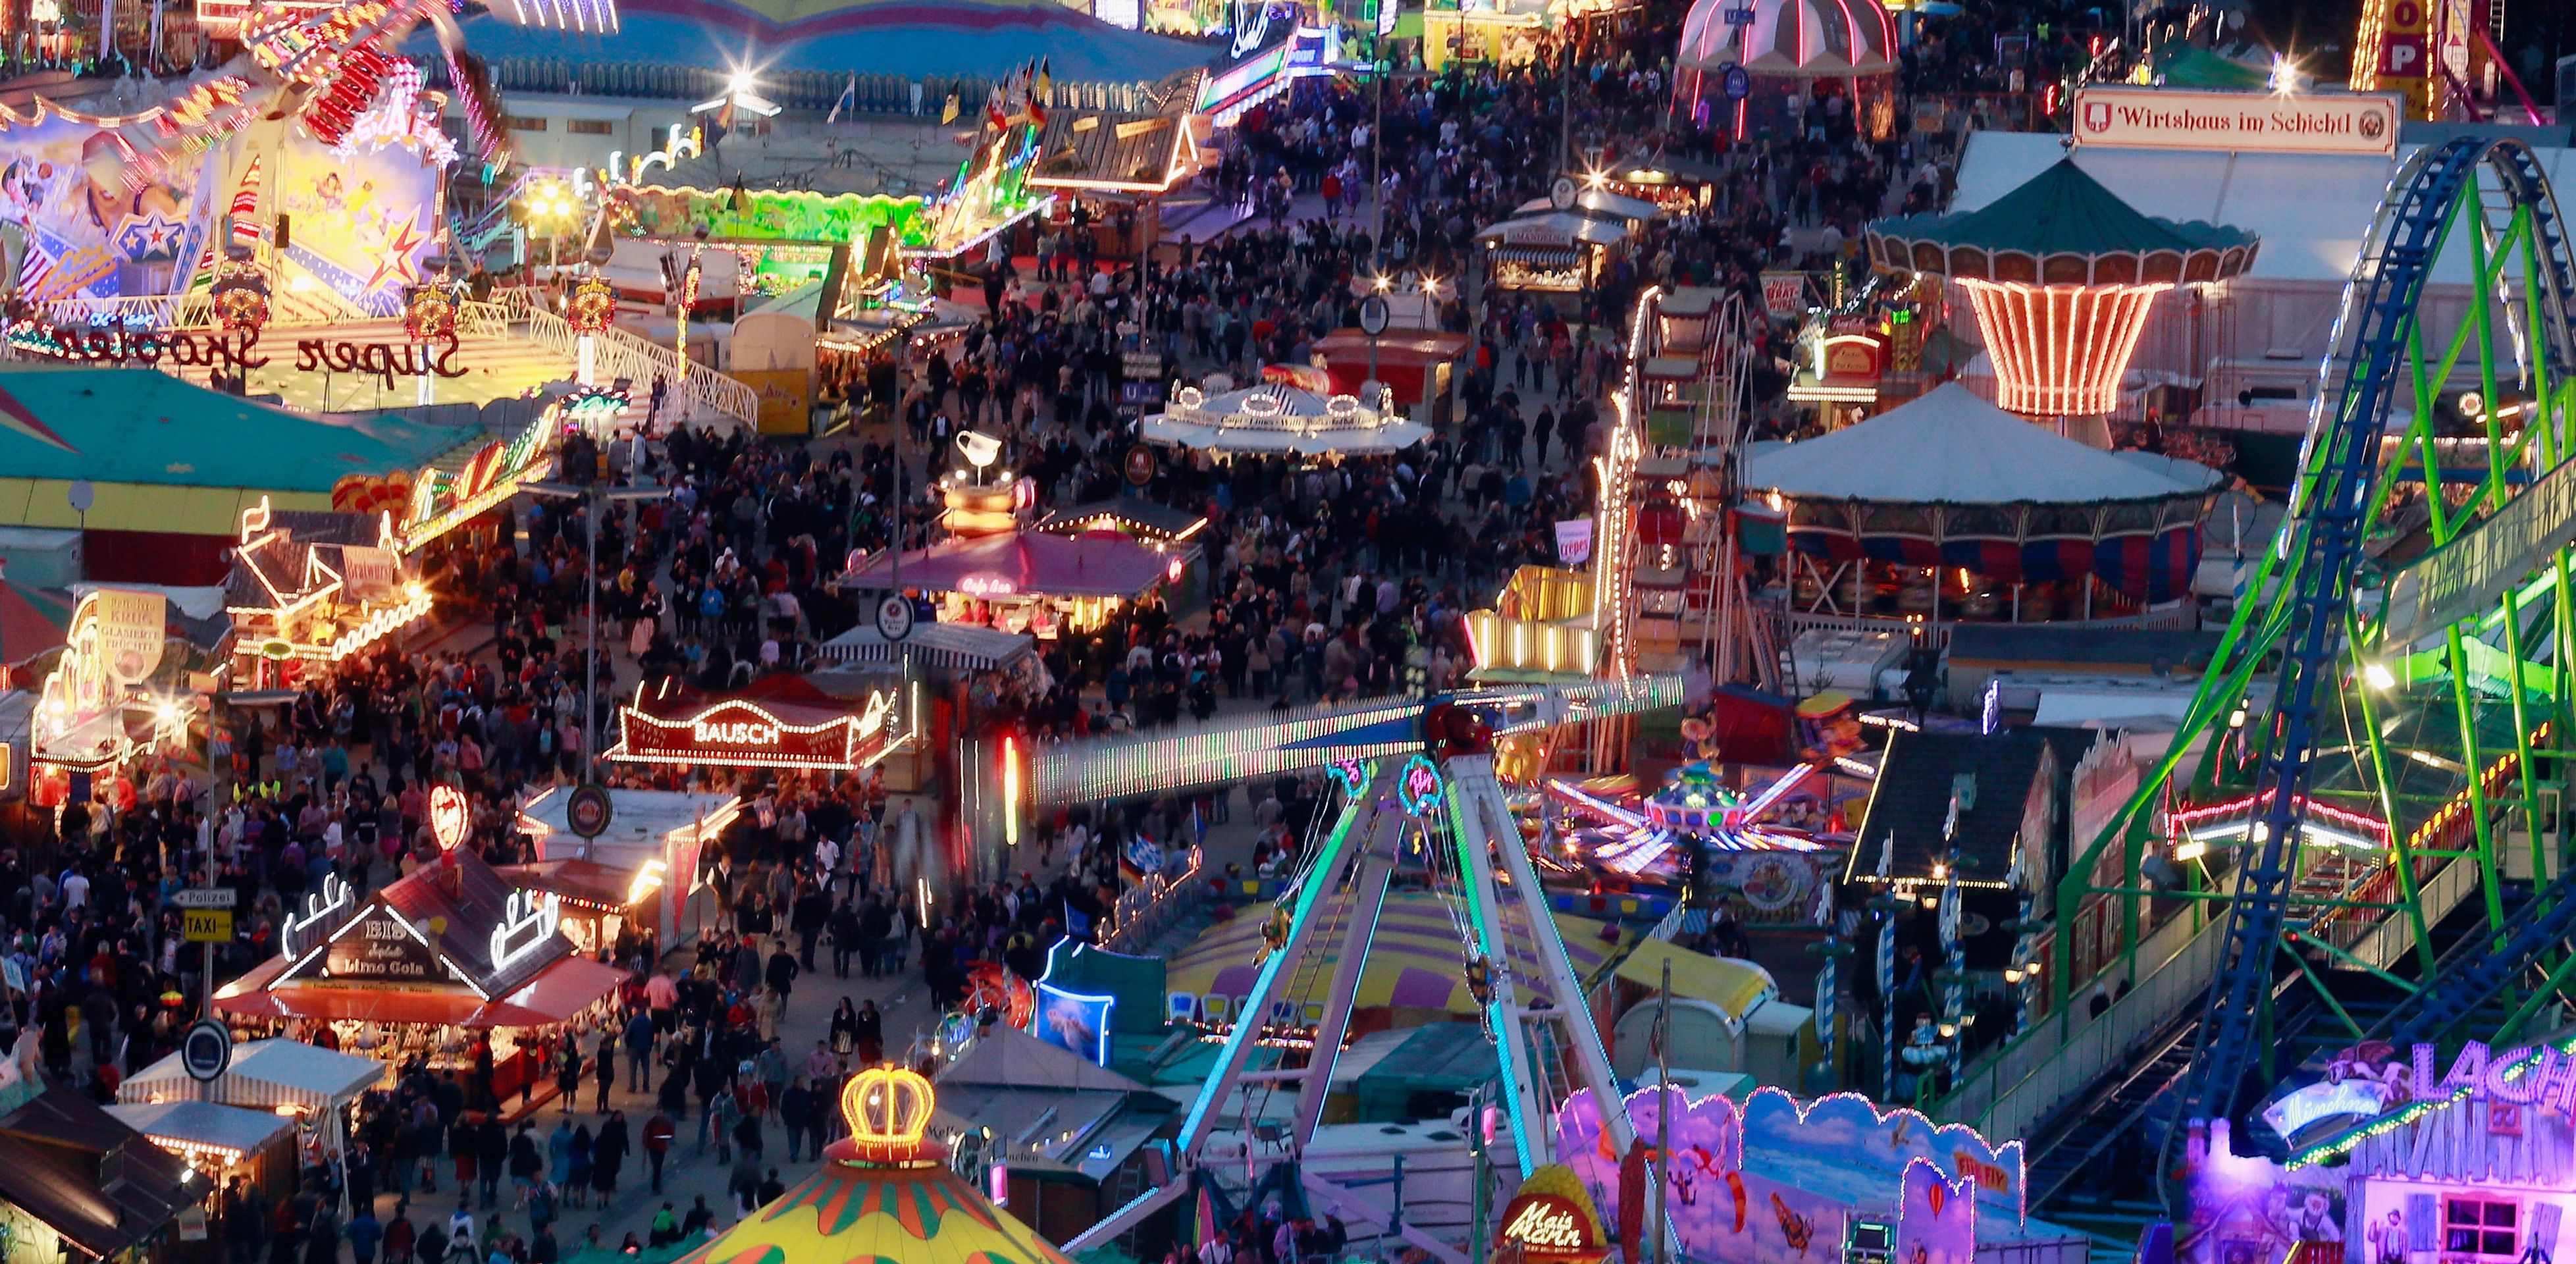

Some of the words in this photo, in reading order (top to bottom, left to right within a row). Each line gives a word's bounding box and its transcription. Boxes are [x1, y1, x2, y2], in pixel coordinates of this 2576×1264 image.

[2118, 105, 2230, 133] Wirtshaus
[2239, 111, 2263, 133] im
[2271, 111, 2351, 136] Schichtl
[1126, 386, 1137, 400] U
[694, 722, 780, 745] BAUSCH
[188, 891, 230, 903] Polizei
[188, 917, 217, 934] TAXI
[365, 920, 407, 940] EIS
[2282, 1084, 2379, 1135] Münchner
